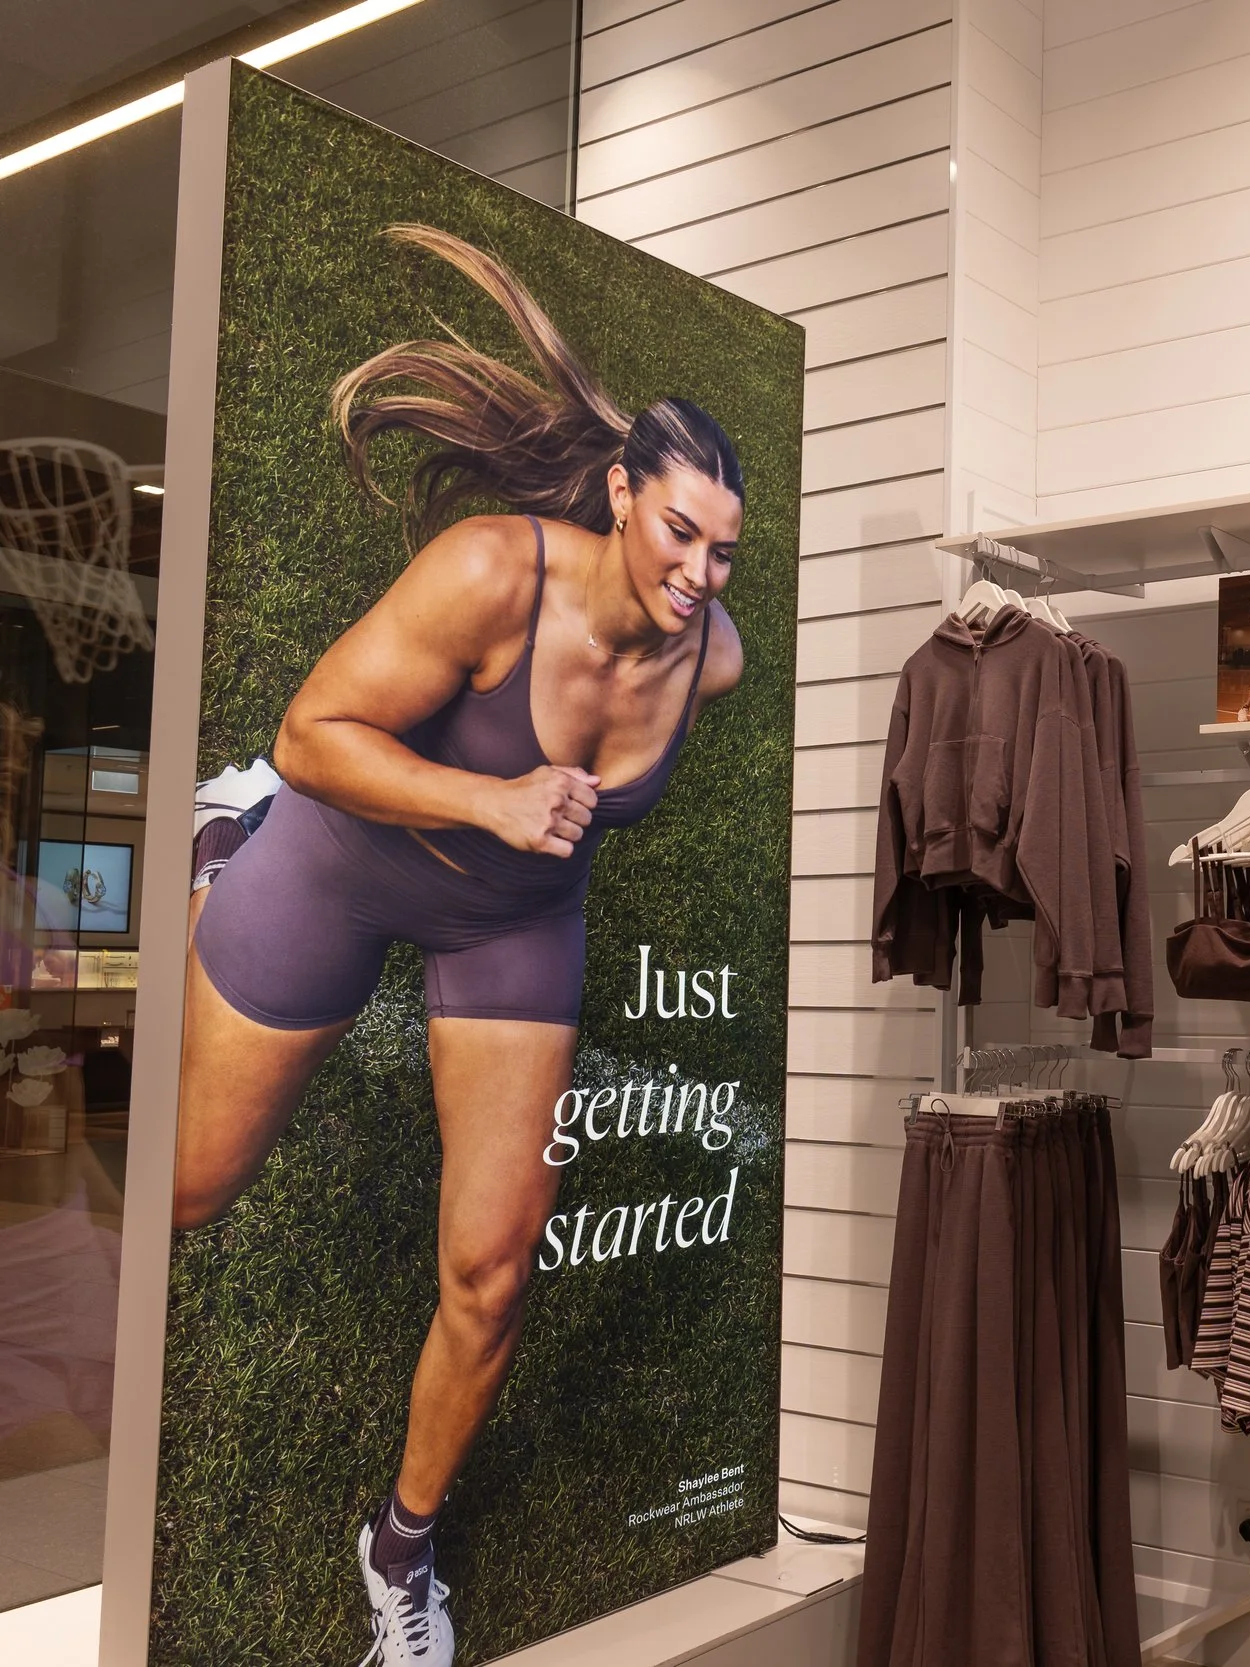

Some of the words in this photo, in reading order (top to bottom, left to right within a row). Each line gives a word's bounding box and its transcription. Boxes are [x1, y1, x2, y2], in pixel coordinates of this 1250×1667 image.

[625, 945, 738, 1019] Just
[543, 1064, 740, 1166] getting
[539, 1167, 739, 1271] started
[628, 1501, 681, 1527] Rockwear
[682, 1480, 745, 1508] Ambassador
[678, 1472, 719, 1493] Shaylee
[721, 1463, 745, 1479] Bent
[674, 1507, 708, 1529] NRLW
[708, 1498, 744, 1517] Athlete
